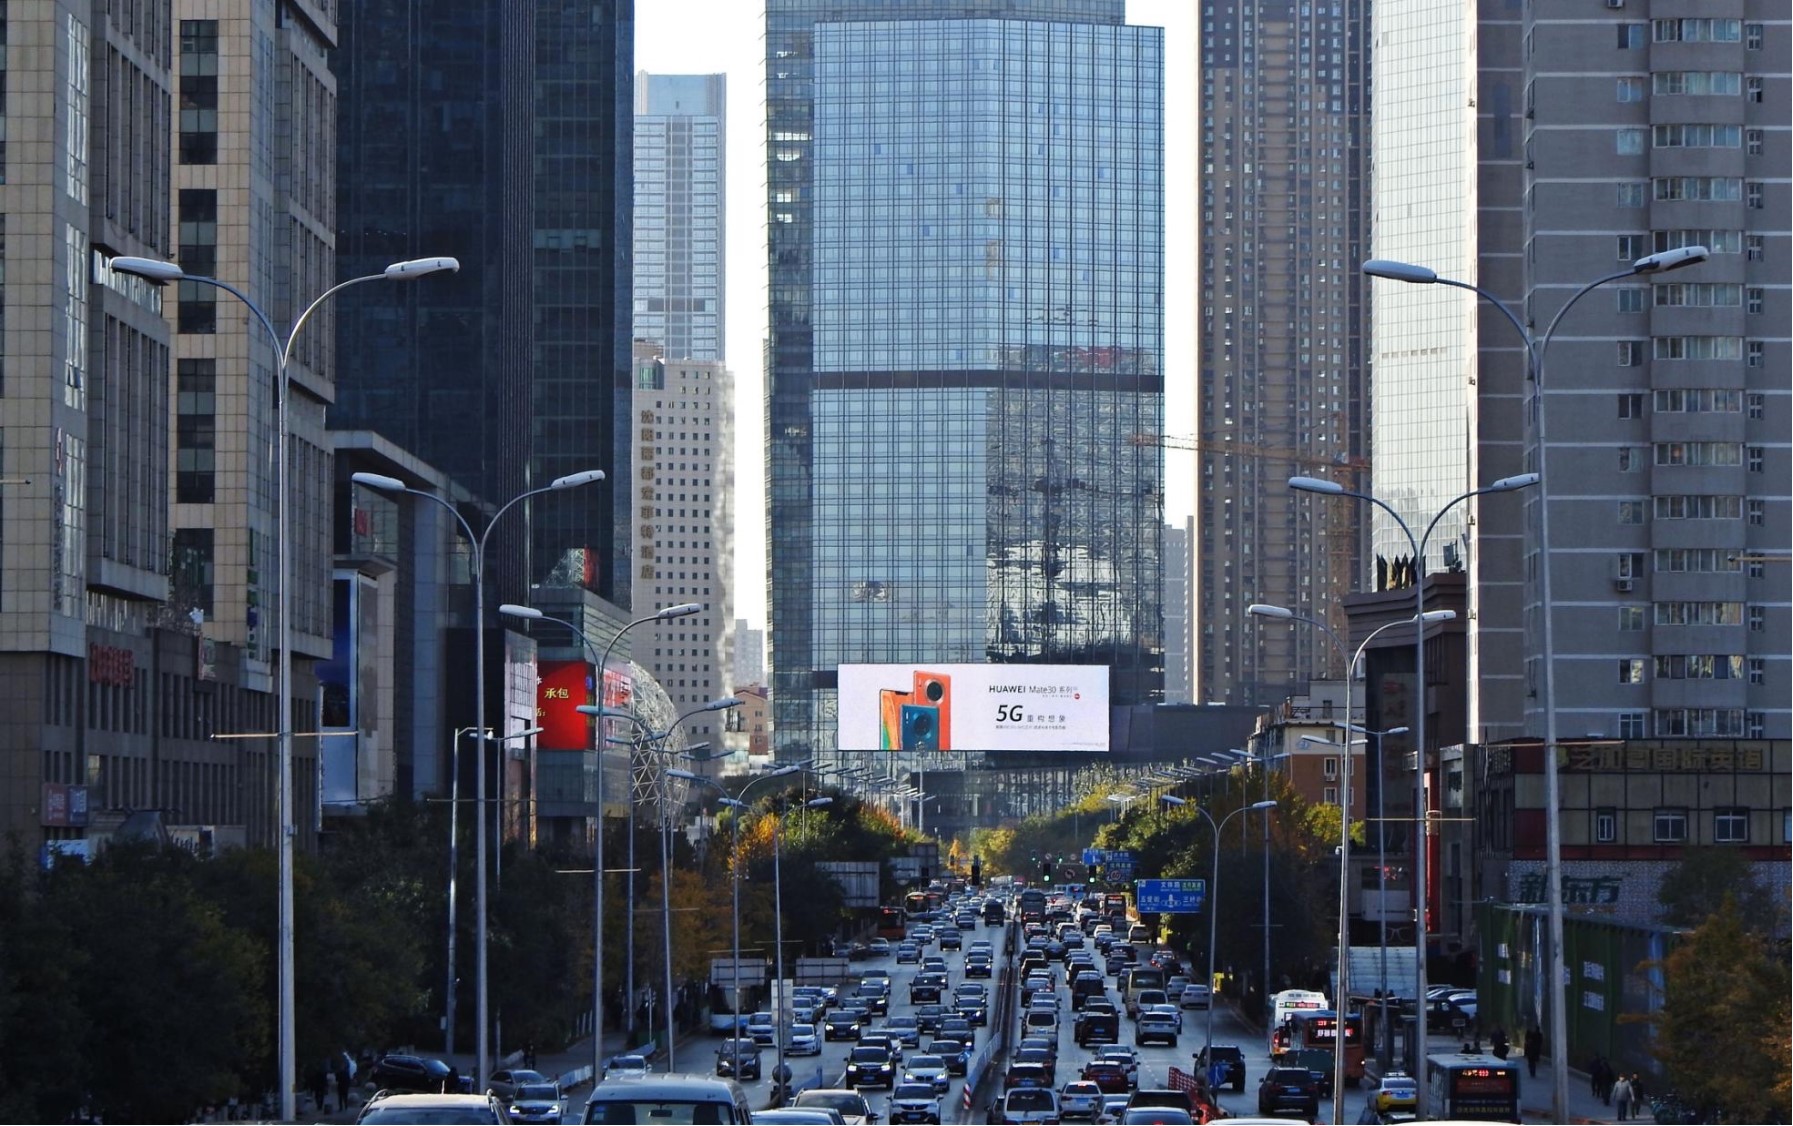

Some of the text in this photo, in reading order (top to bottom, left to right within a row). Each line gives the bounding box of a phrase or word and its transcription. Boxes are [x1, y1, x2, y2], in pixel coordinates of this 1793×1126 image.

[544, 687, 569, 699] 承包
[989, 685, 1026, 693] HUAWEI
[1029, 685, 1057, 694] Mate30
[996, 704, 1023, 722] 5G
[1571, 746, 1763, 772] 芝加哥国际英语
